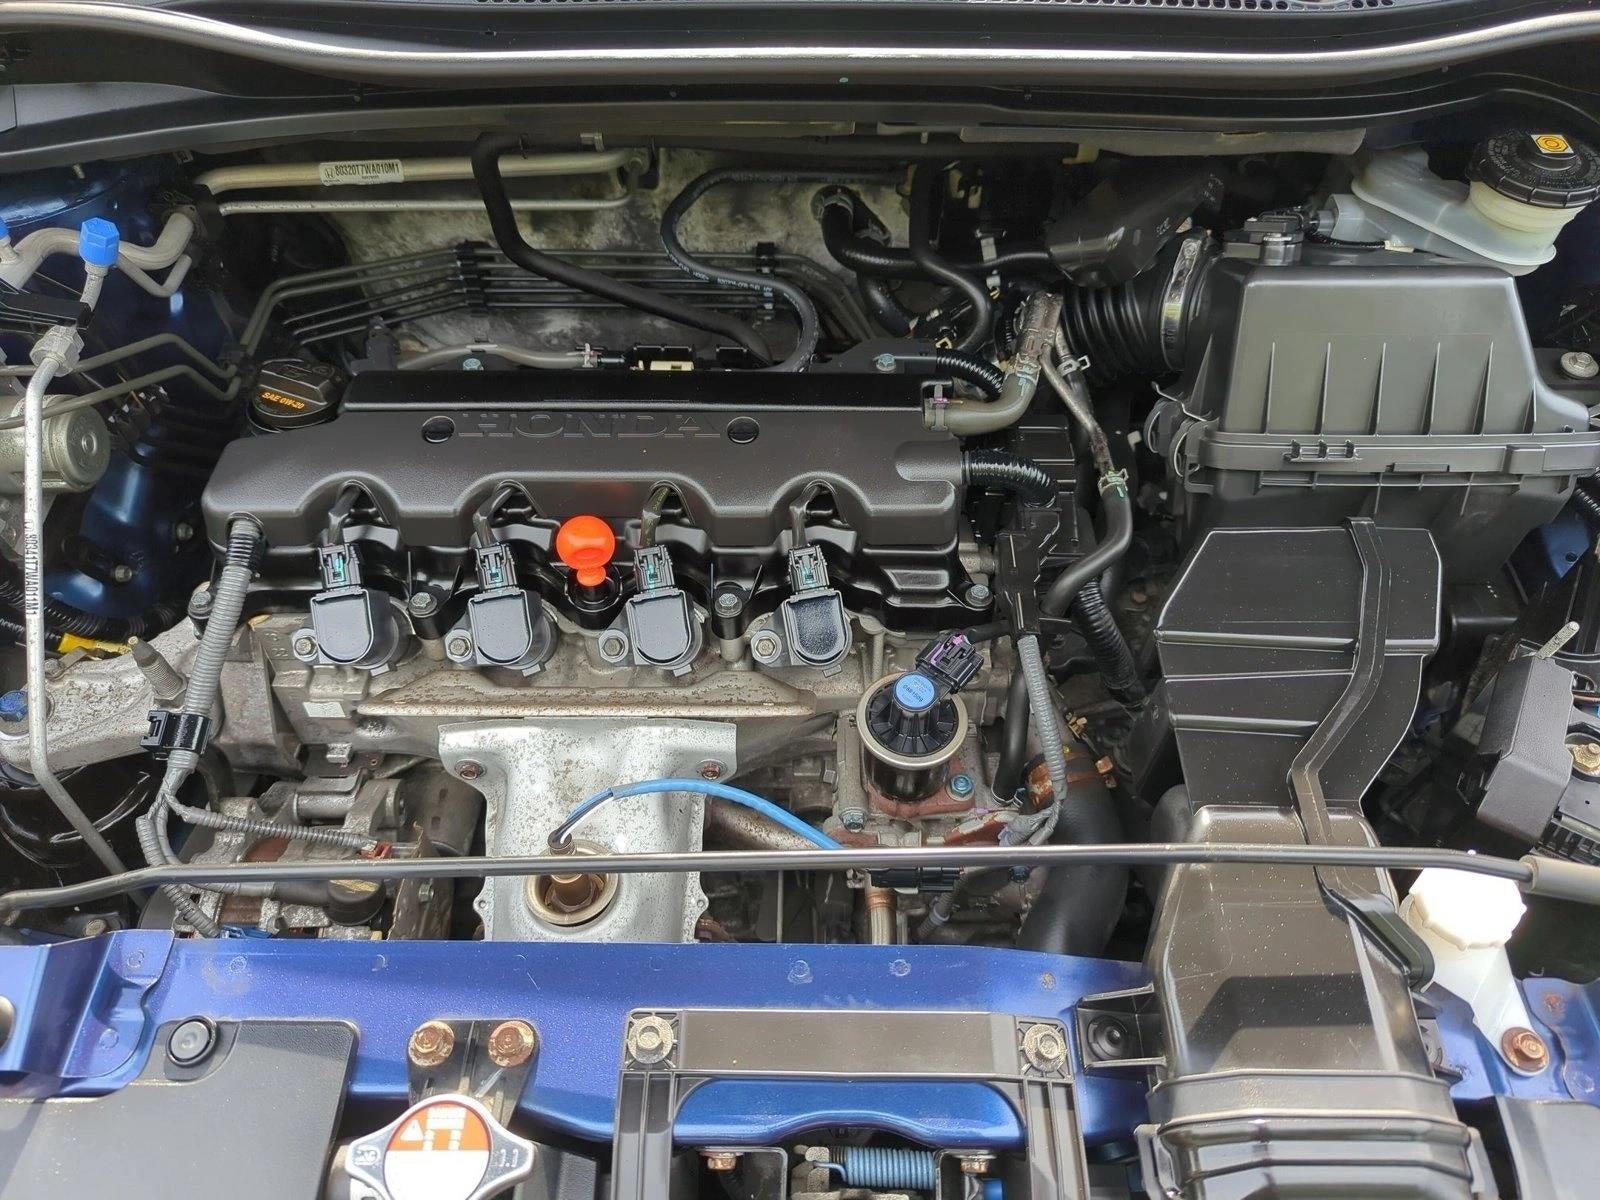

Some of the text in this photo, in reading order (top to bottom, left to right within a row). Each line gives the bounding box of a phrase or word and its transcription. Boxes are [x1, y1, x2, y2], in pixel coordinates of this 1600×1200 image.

[262, 391, 305, 410] SAE 0W-20
[458, 412, 721, 438] HONDA
